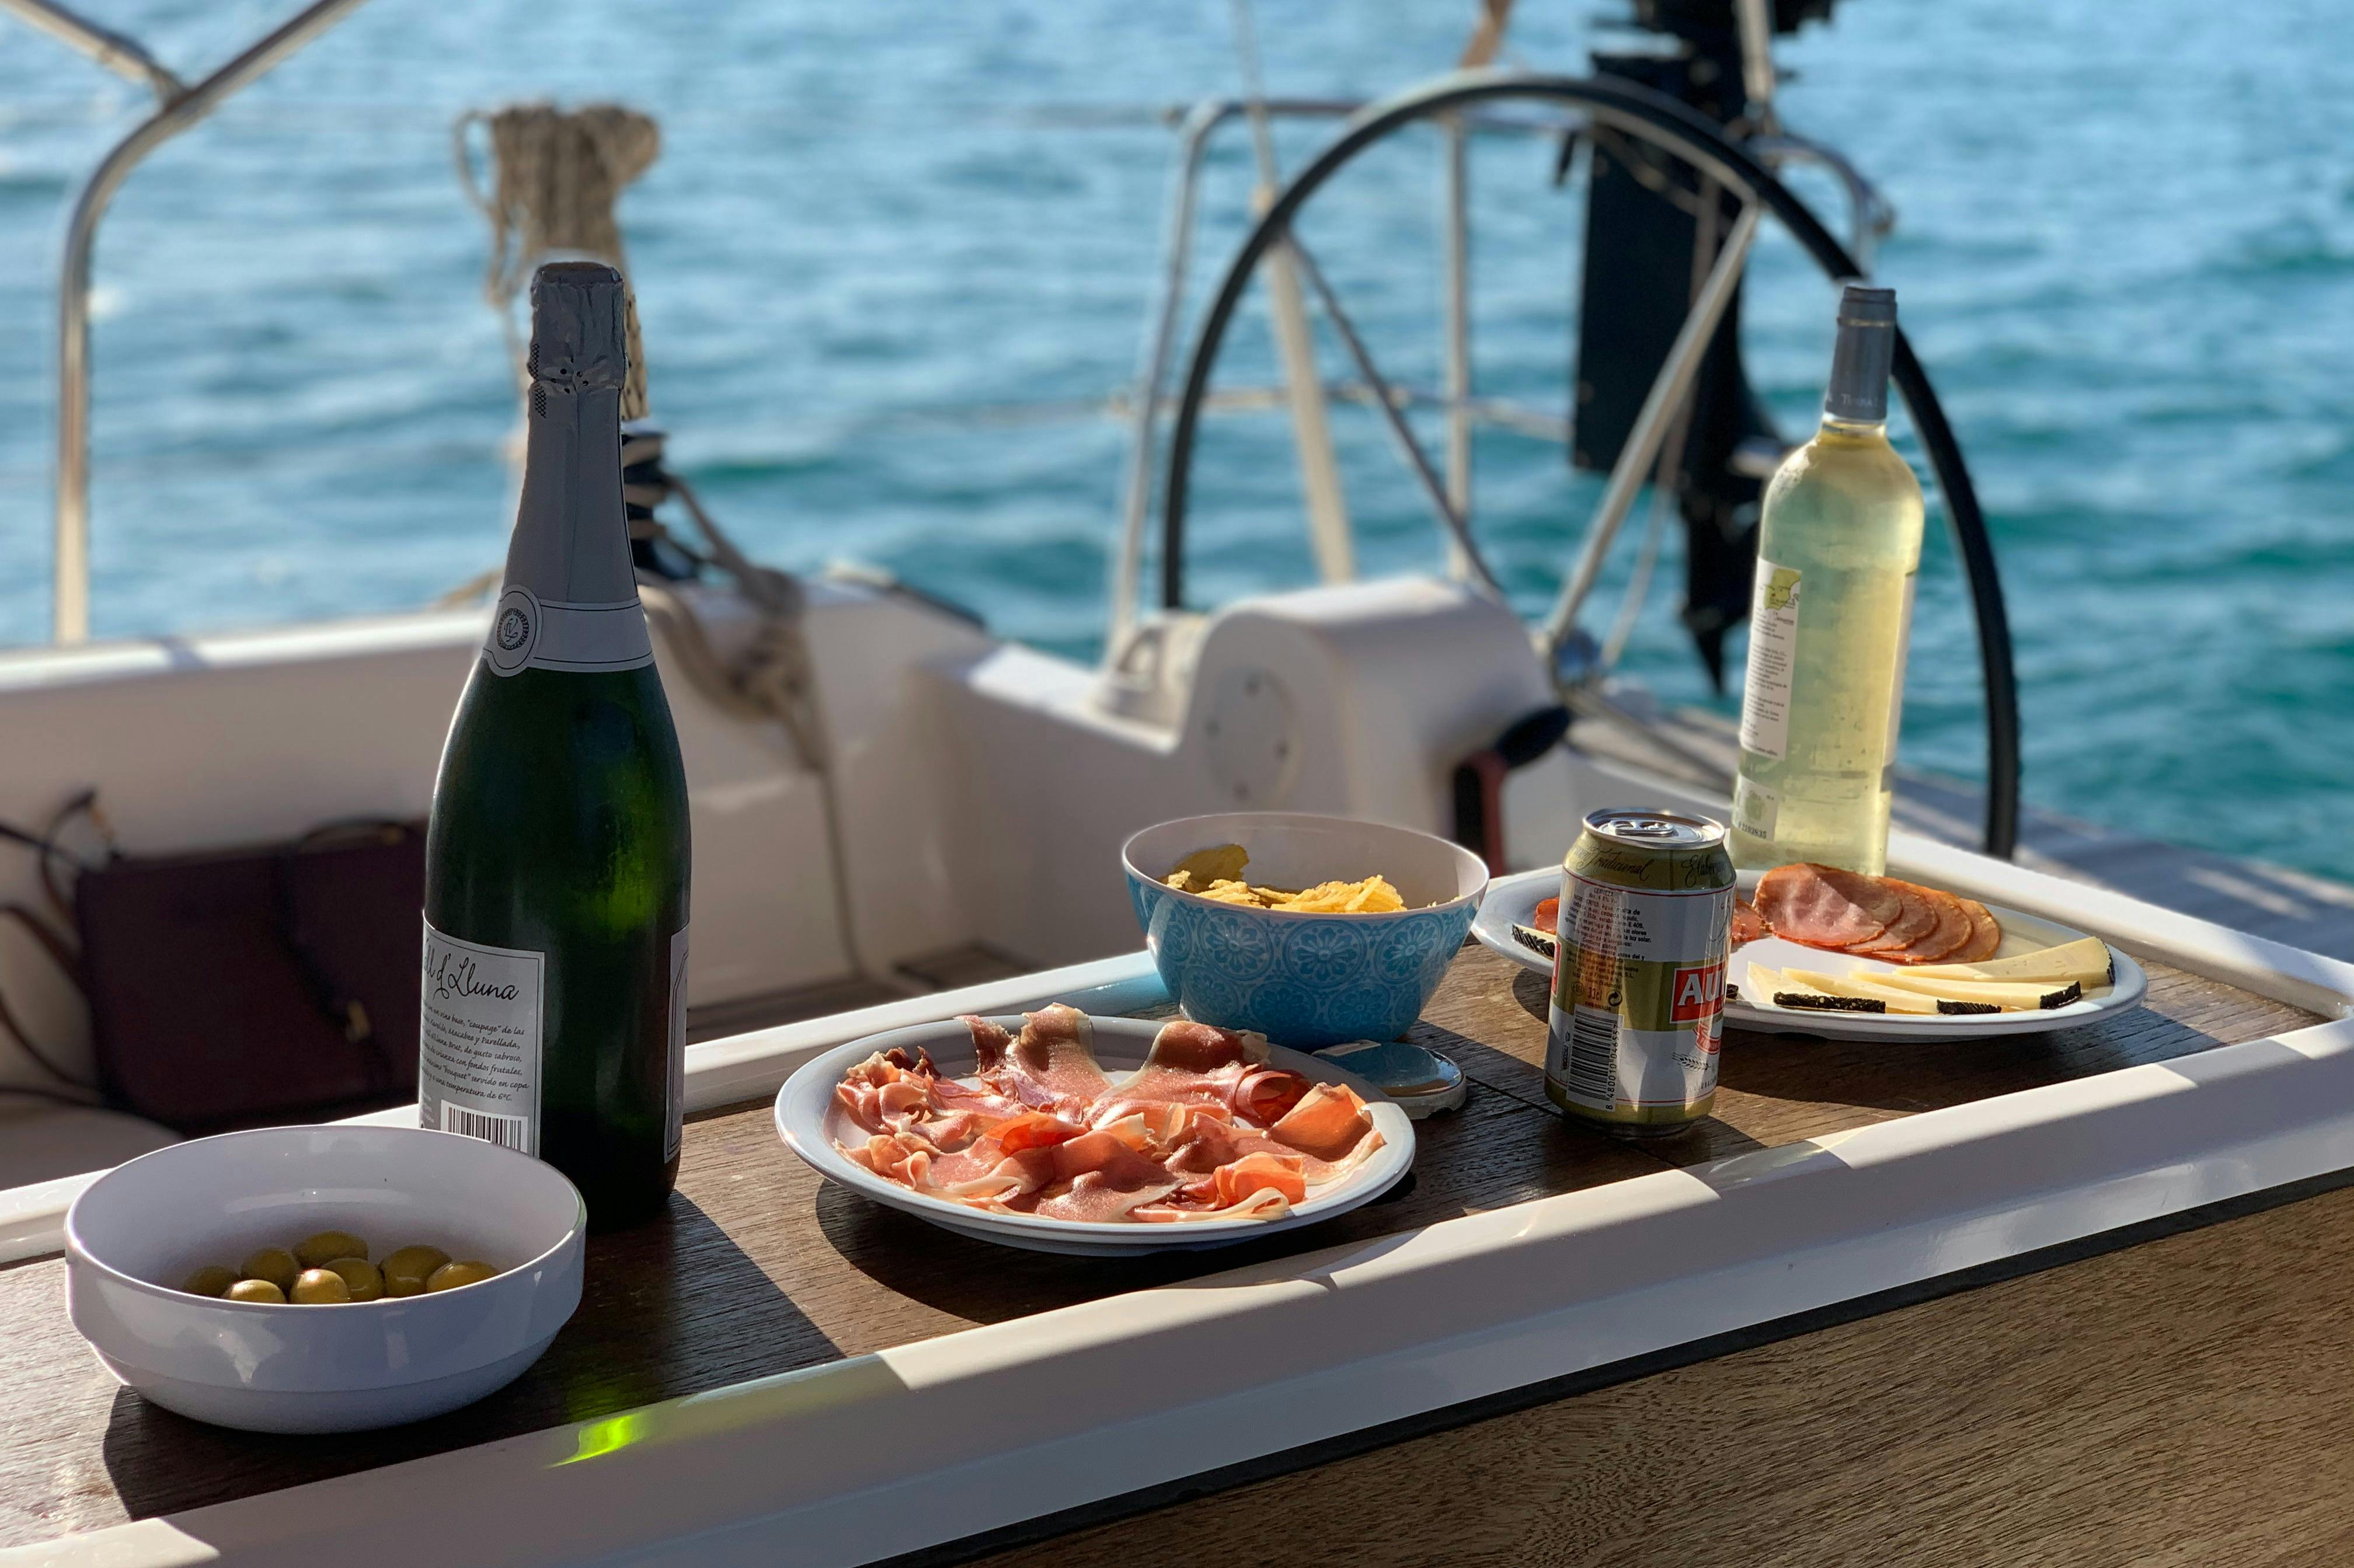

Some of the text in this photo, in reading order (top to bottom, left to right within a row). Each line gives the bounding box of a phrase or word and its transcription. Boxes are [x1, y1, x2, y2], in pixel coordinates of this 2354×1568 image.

[1677, 970, 1725, 1006] AU
[502, 1025, 512, 1034] de
[513, 1026, 525, 1036] las
[473, 1037, 480, 1046] y
[481, 1036, 521, 1050] Parellada,
[464, 1046, 472, 1054] de
[472, 1050, 493, 1060] gusto
[494, 1051, 523, 1063] sabroso,
[456, 1058, 468, 1067] con
[466, 1059, 489, 1071] fondos
[488, 1064, 523, 1075] frutales,
[445, 1081, 486, 1097] temperatura
[486, 1090, 497, 1099] de
[471, 1076, 497, 1086] servido
[510, 1082, 530, 1092] copa
